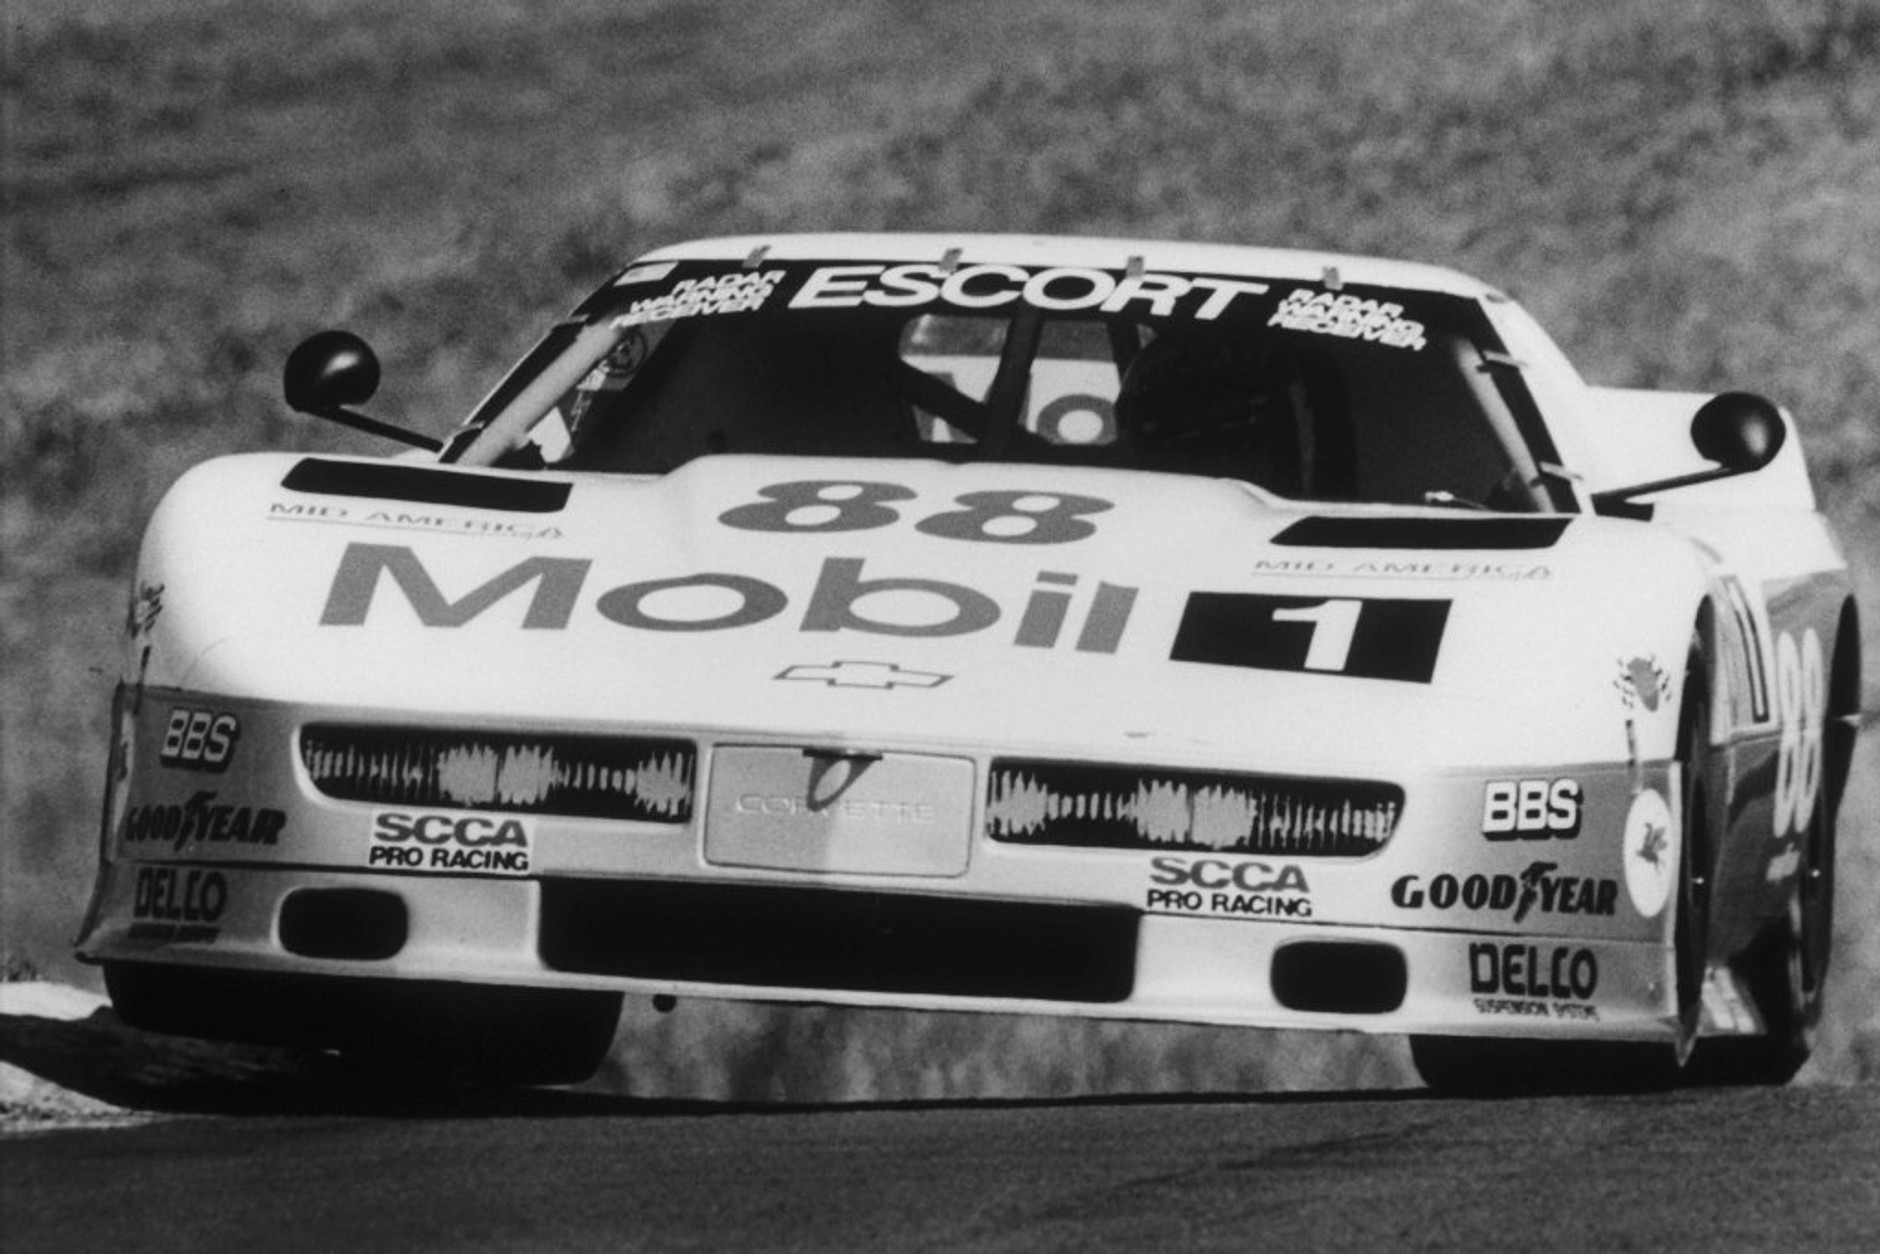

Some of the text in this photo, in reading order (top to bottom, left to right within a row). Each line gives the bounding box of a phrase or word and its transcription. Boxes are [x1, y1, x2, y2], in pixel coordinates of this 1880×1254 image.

[672, 270, 787, 299] RADAR
[788, 263, 1269, 320] ESCORT
[1287, 288, 1404, 320] RADAR
[717, 479, 1116, 545] 88
[319, 541, 1364, 672] Mobil 1
[160, 708, 240, 774] BBS
[125, 790, 287, 852] GOODYEAR
[374, 813, 529, 848] SCCA
[1482, 777, 1585, 842] BBS
[368, 845, 530, 871] PRO RACING
[1149, 856, 1311, 893] SCCA
[133, 867, 228, 923] DELCO
[1146, 888, 1313, 918] PRO RACING
[1391, 861, 1619, 923] GOODYEAR
[1469, 942, 1599, 1000] DELCO
